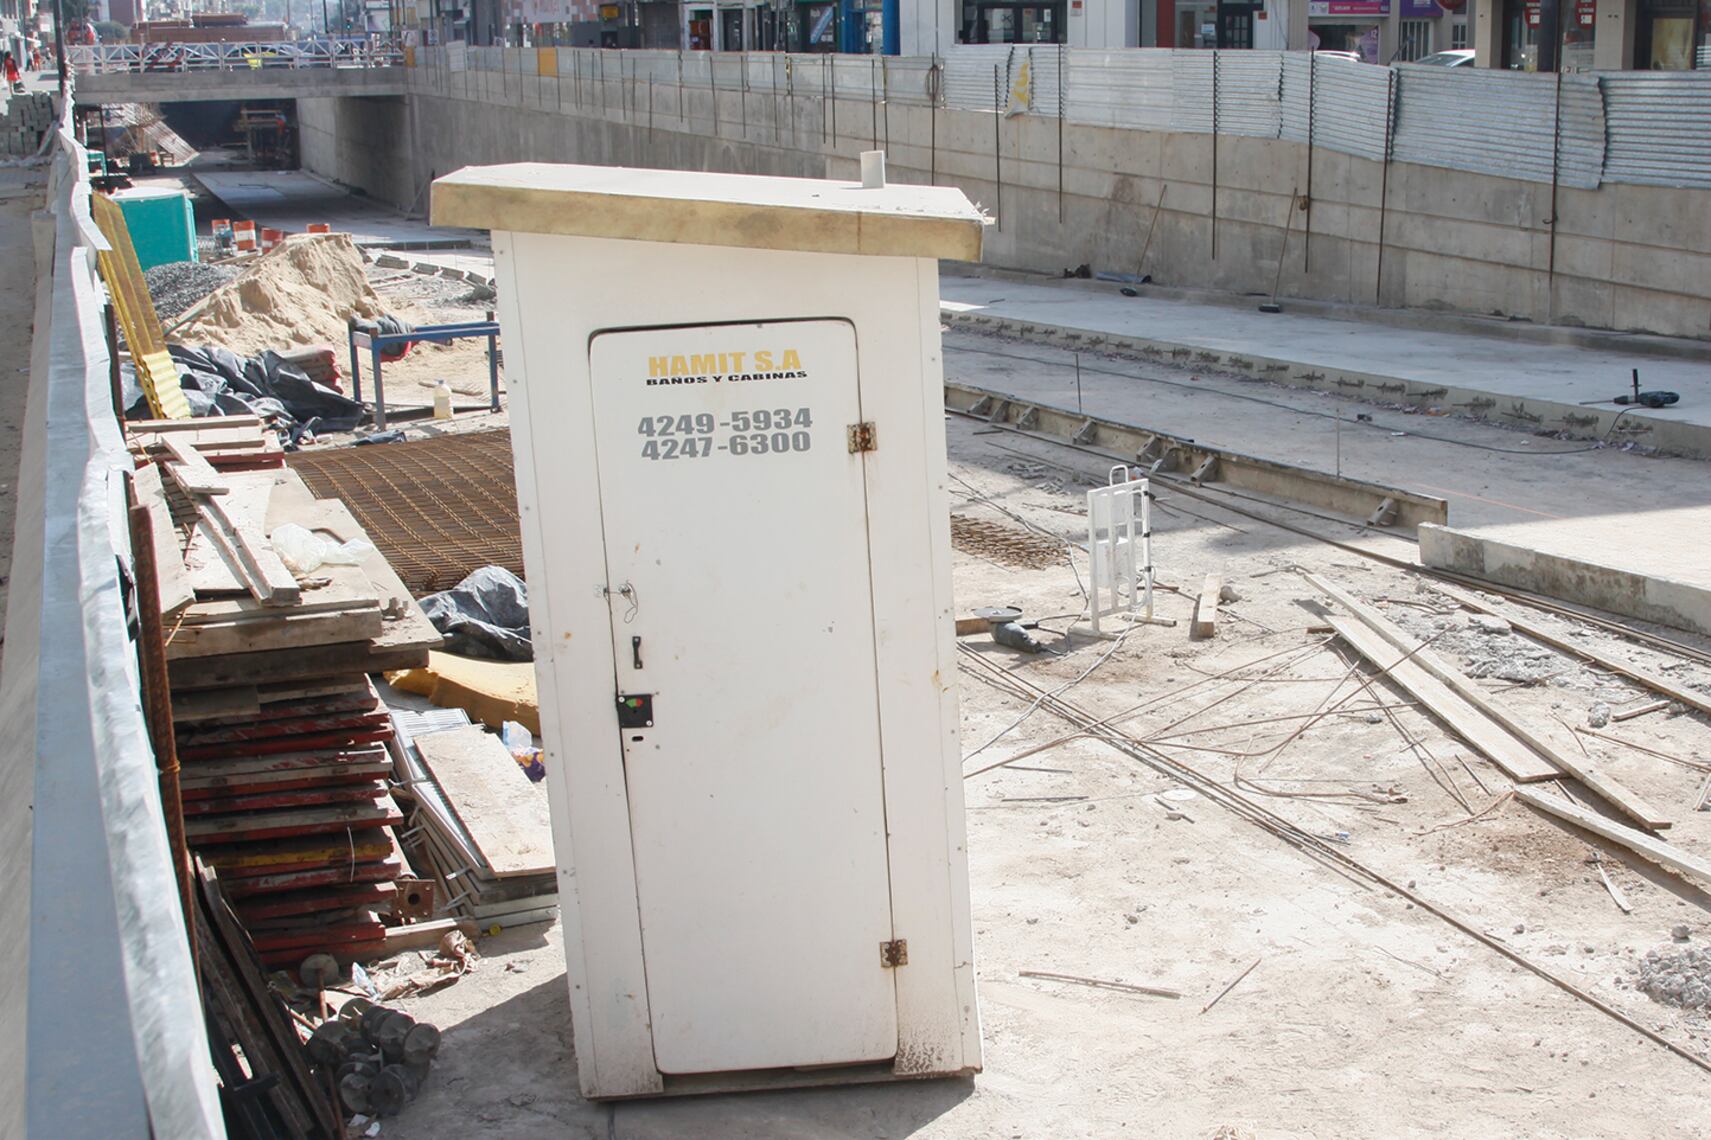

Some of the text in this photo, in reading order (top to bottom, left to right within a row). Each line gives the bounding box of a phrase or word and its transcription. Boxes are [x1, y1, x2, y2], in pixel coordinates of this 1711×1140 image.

[649, 349, 802, 377] HAMIT S.A
[712, 375, 722, 383] Y
[727, 371, 808, 382] CABINAS
[638, 408, 813, 437] 4249-5934
[641, 431, 811, 461] 4247-6300
